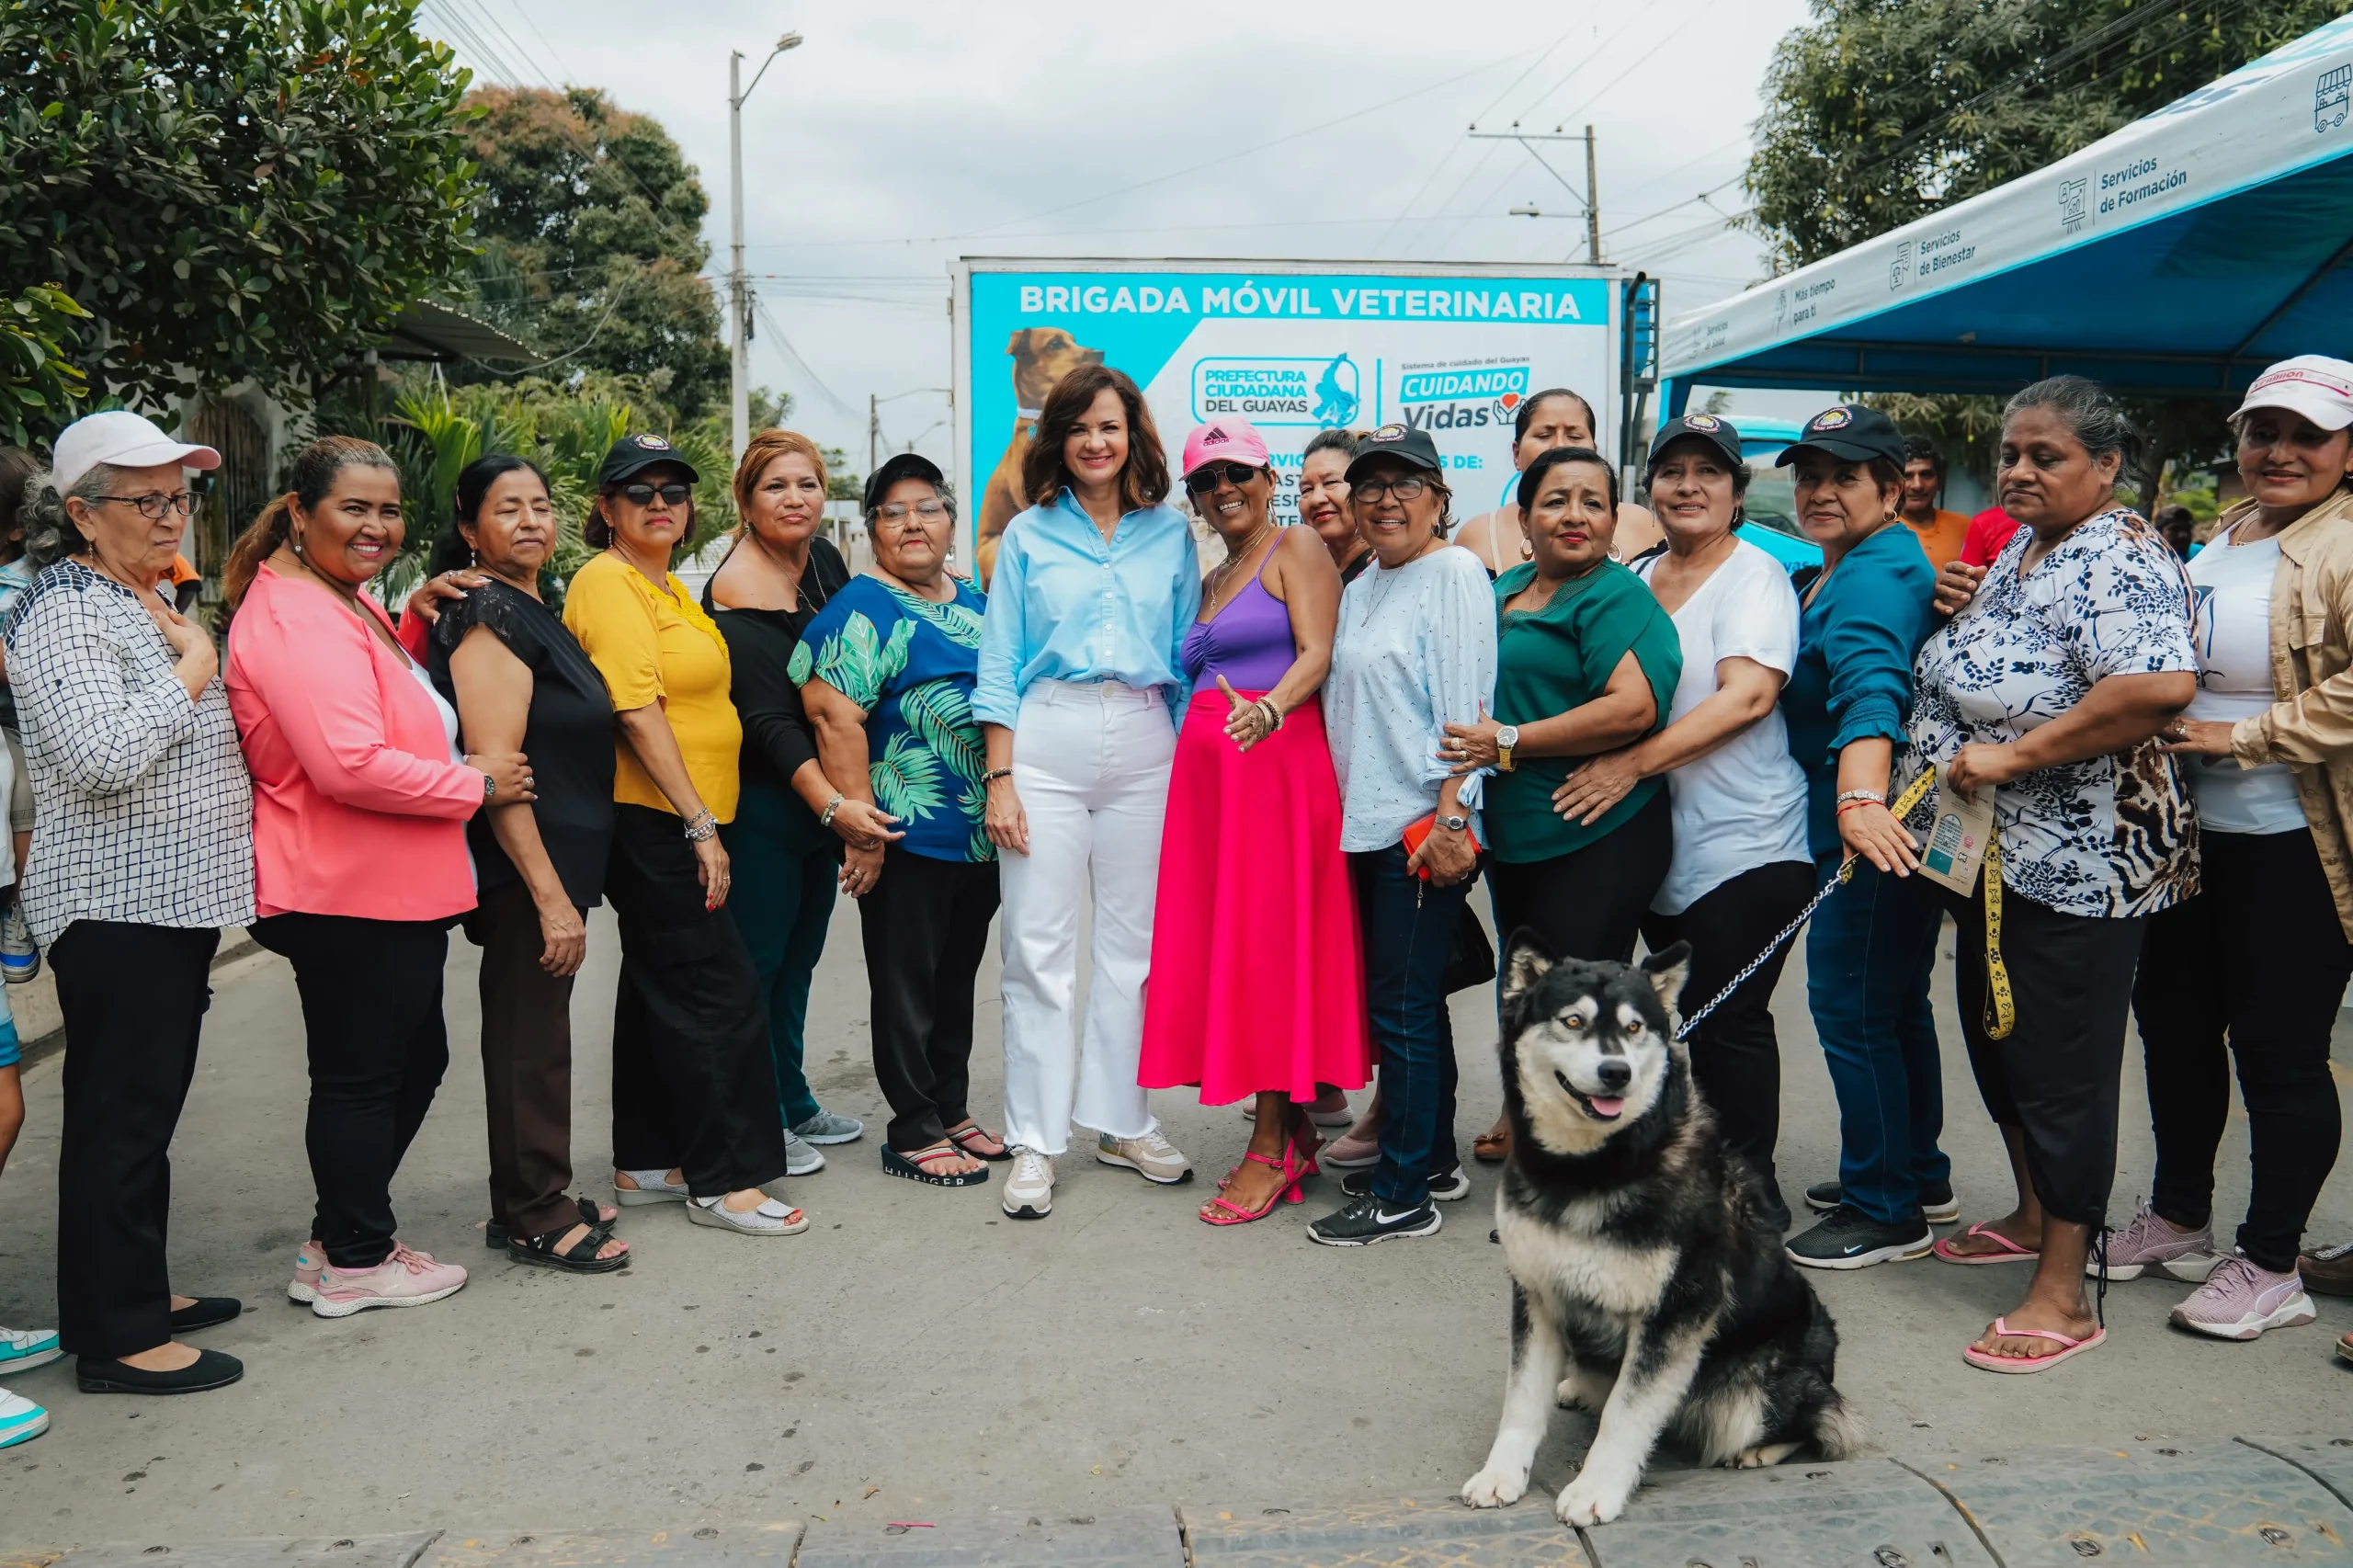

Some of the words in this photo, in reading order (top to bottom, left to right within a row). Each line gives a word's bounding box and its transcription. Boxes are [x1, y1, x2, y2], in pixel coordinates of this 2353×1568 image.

[2101, 157, 2157, 189] Servicios
[2100, 197, 2115, 213] de
[2118, 169, 2187, 208] Formación
[1920, 230, 1961, 256] Servicios
[1919, 261, 1930, 276] de
[1932, 245, 1976, 272] Bienestar
[1020, 286, 1191, 313] BRIGADA
[1202, 279, 1321, 315] MÓVIL
[1331, 288, 1581, 320] VETERINARIA
[1794, 290, 1809, 302] Más
[1810, 278, 1836, 298] tiempo
[1793, 309, 1810, 324] para
[1810, 303, 1817, 318] ti
[1449, 358, 1483, 367] cuidado
[1484, 357, 1498, 365] del
[1500, 356, 1530, 365] Guayas
[1205, 369, 1308, 383] PREFECTURA
[1404, 371, 1525, 397] CUIDANDO
[1205, 384, 1308, 398] CIUDADANA
[1205, 400, 1238, 413] DEL
[1243, 400, 1308, 413] GUAYAS
[1404, 403, 1490, 430] Vidas
[1203, 438, 1230, 447] adidas
[1453, 455, 1483, 469] DE:
